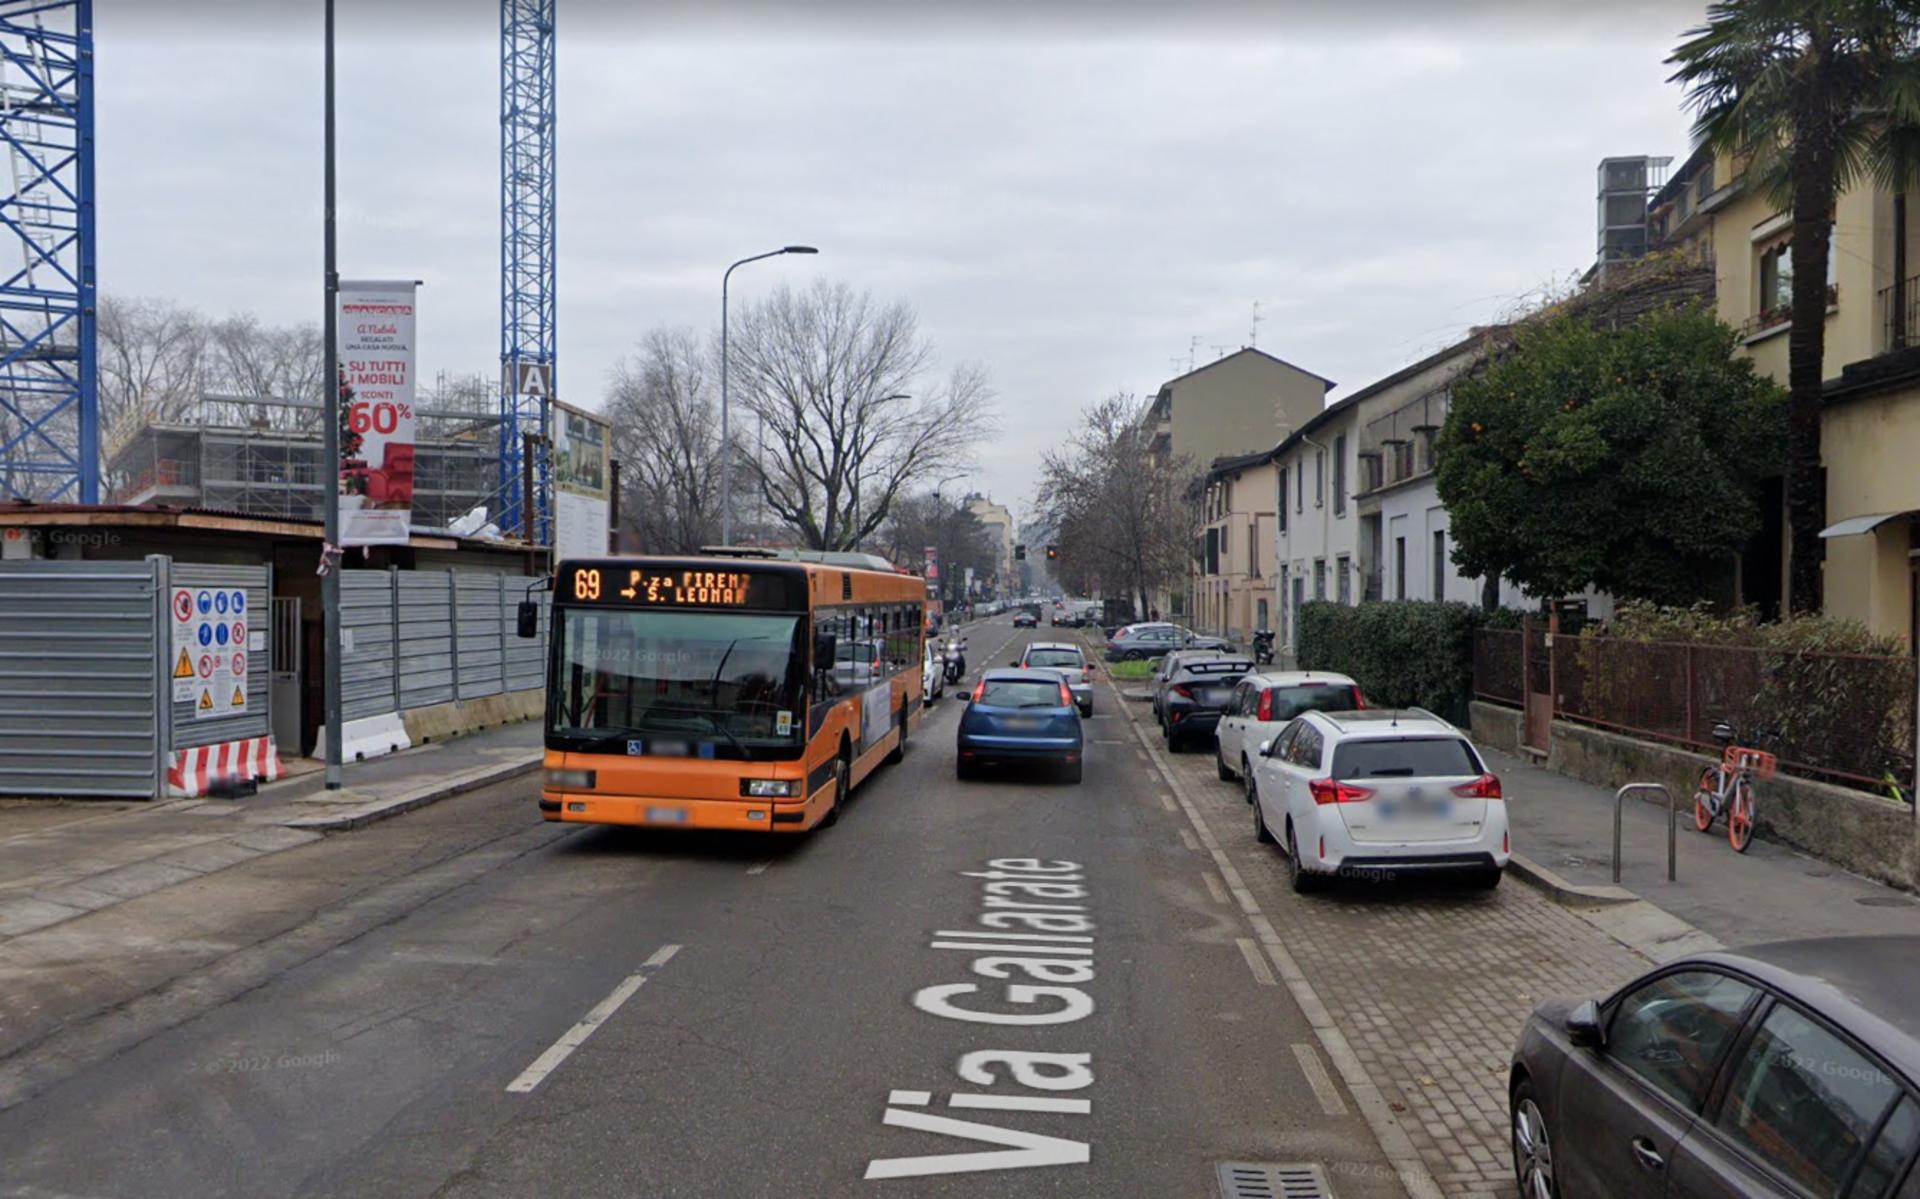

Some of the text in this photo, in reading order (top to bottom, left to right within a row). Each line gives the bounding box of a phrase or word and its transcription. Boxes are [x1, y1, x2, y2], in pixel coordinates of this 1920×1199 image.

[349, 361, 406, 372] SU TUTTI
[358, 374, 405, 385] MOBILI
[522, 366, 546, 394] A
[360, 391, 393, 399] SCONTI
[575, 569, 600, 599] 69
[648, 586, 665, 601] S.
[863, 857, 1097, 1180] Via Gallarate
